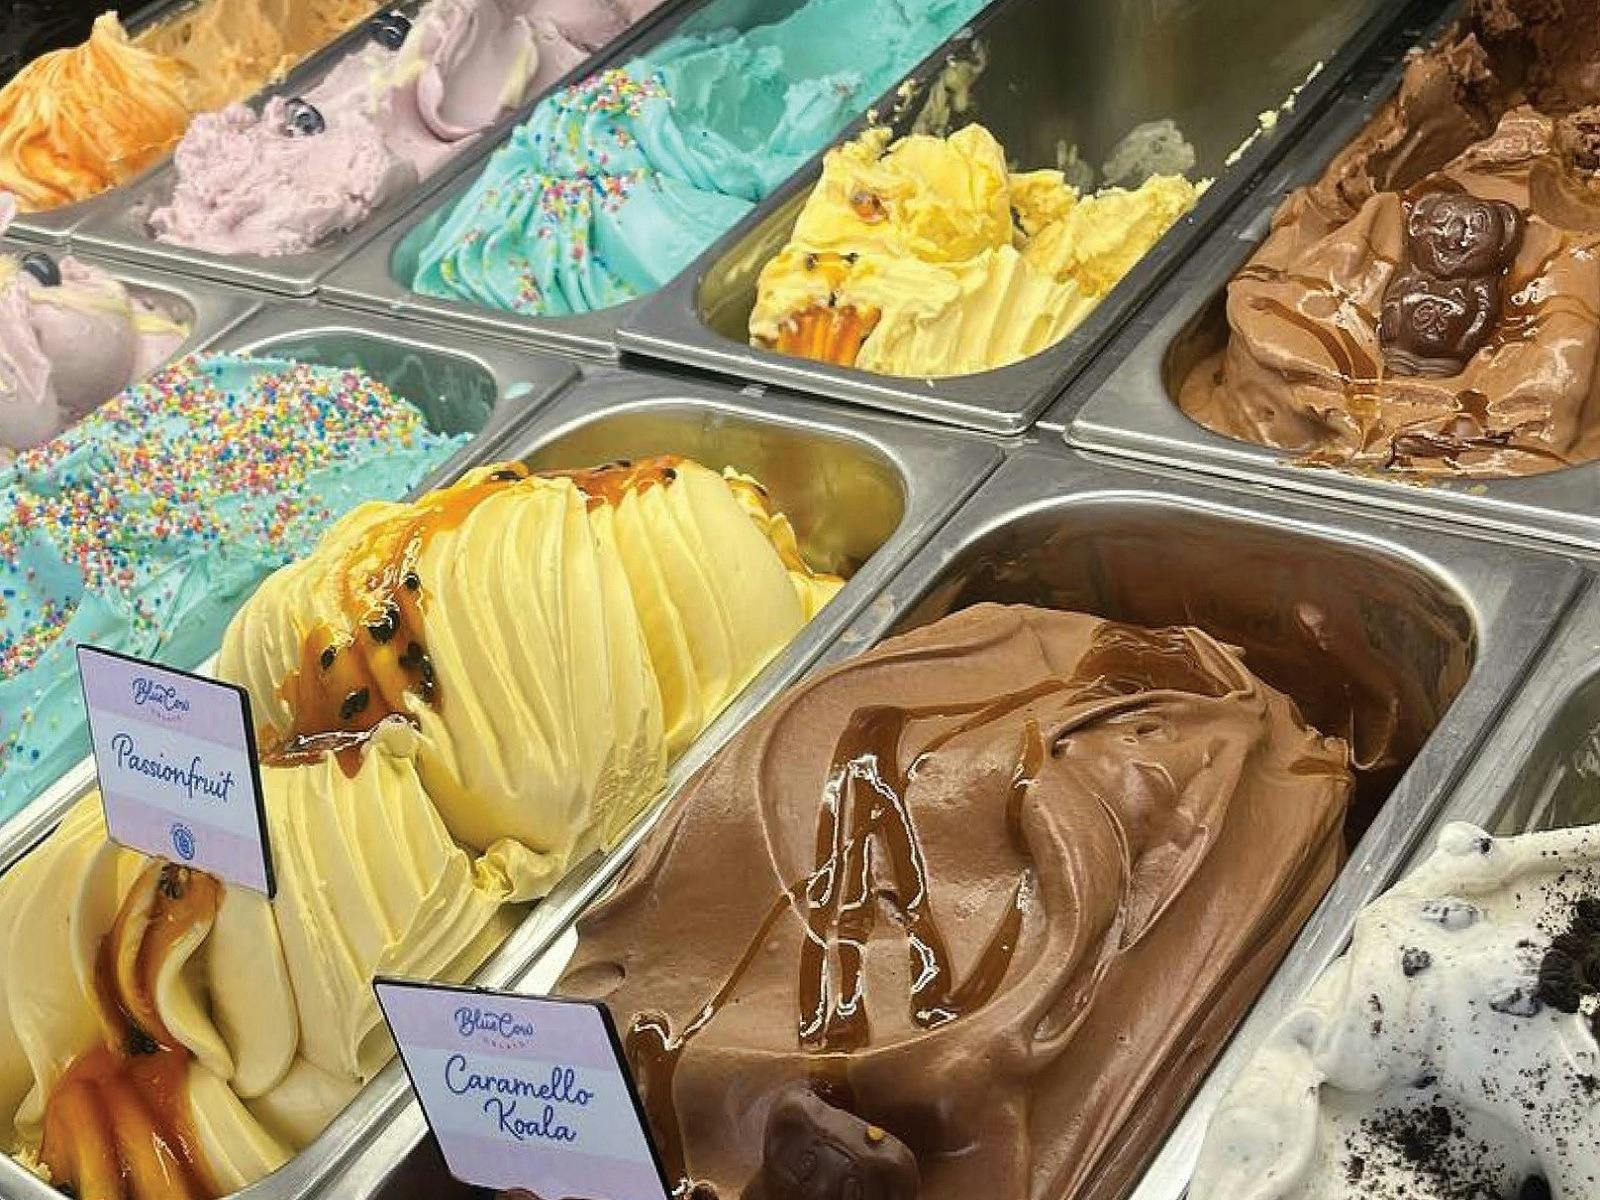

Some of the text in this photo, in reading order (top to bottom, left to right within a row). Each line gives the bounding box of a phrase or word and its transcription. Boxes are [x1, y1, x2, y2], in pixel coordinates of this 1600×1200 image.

[112, 732, 234, 802] Passionfruit
[445, 1054, 594, 1105] Caramello
[484, 1097, 577, 1141] Koala
